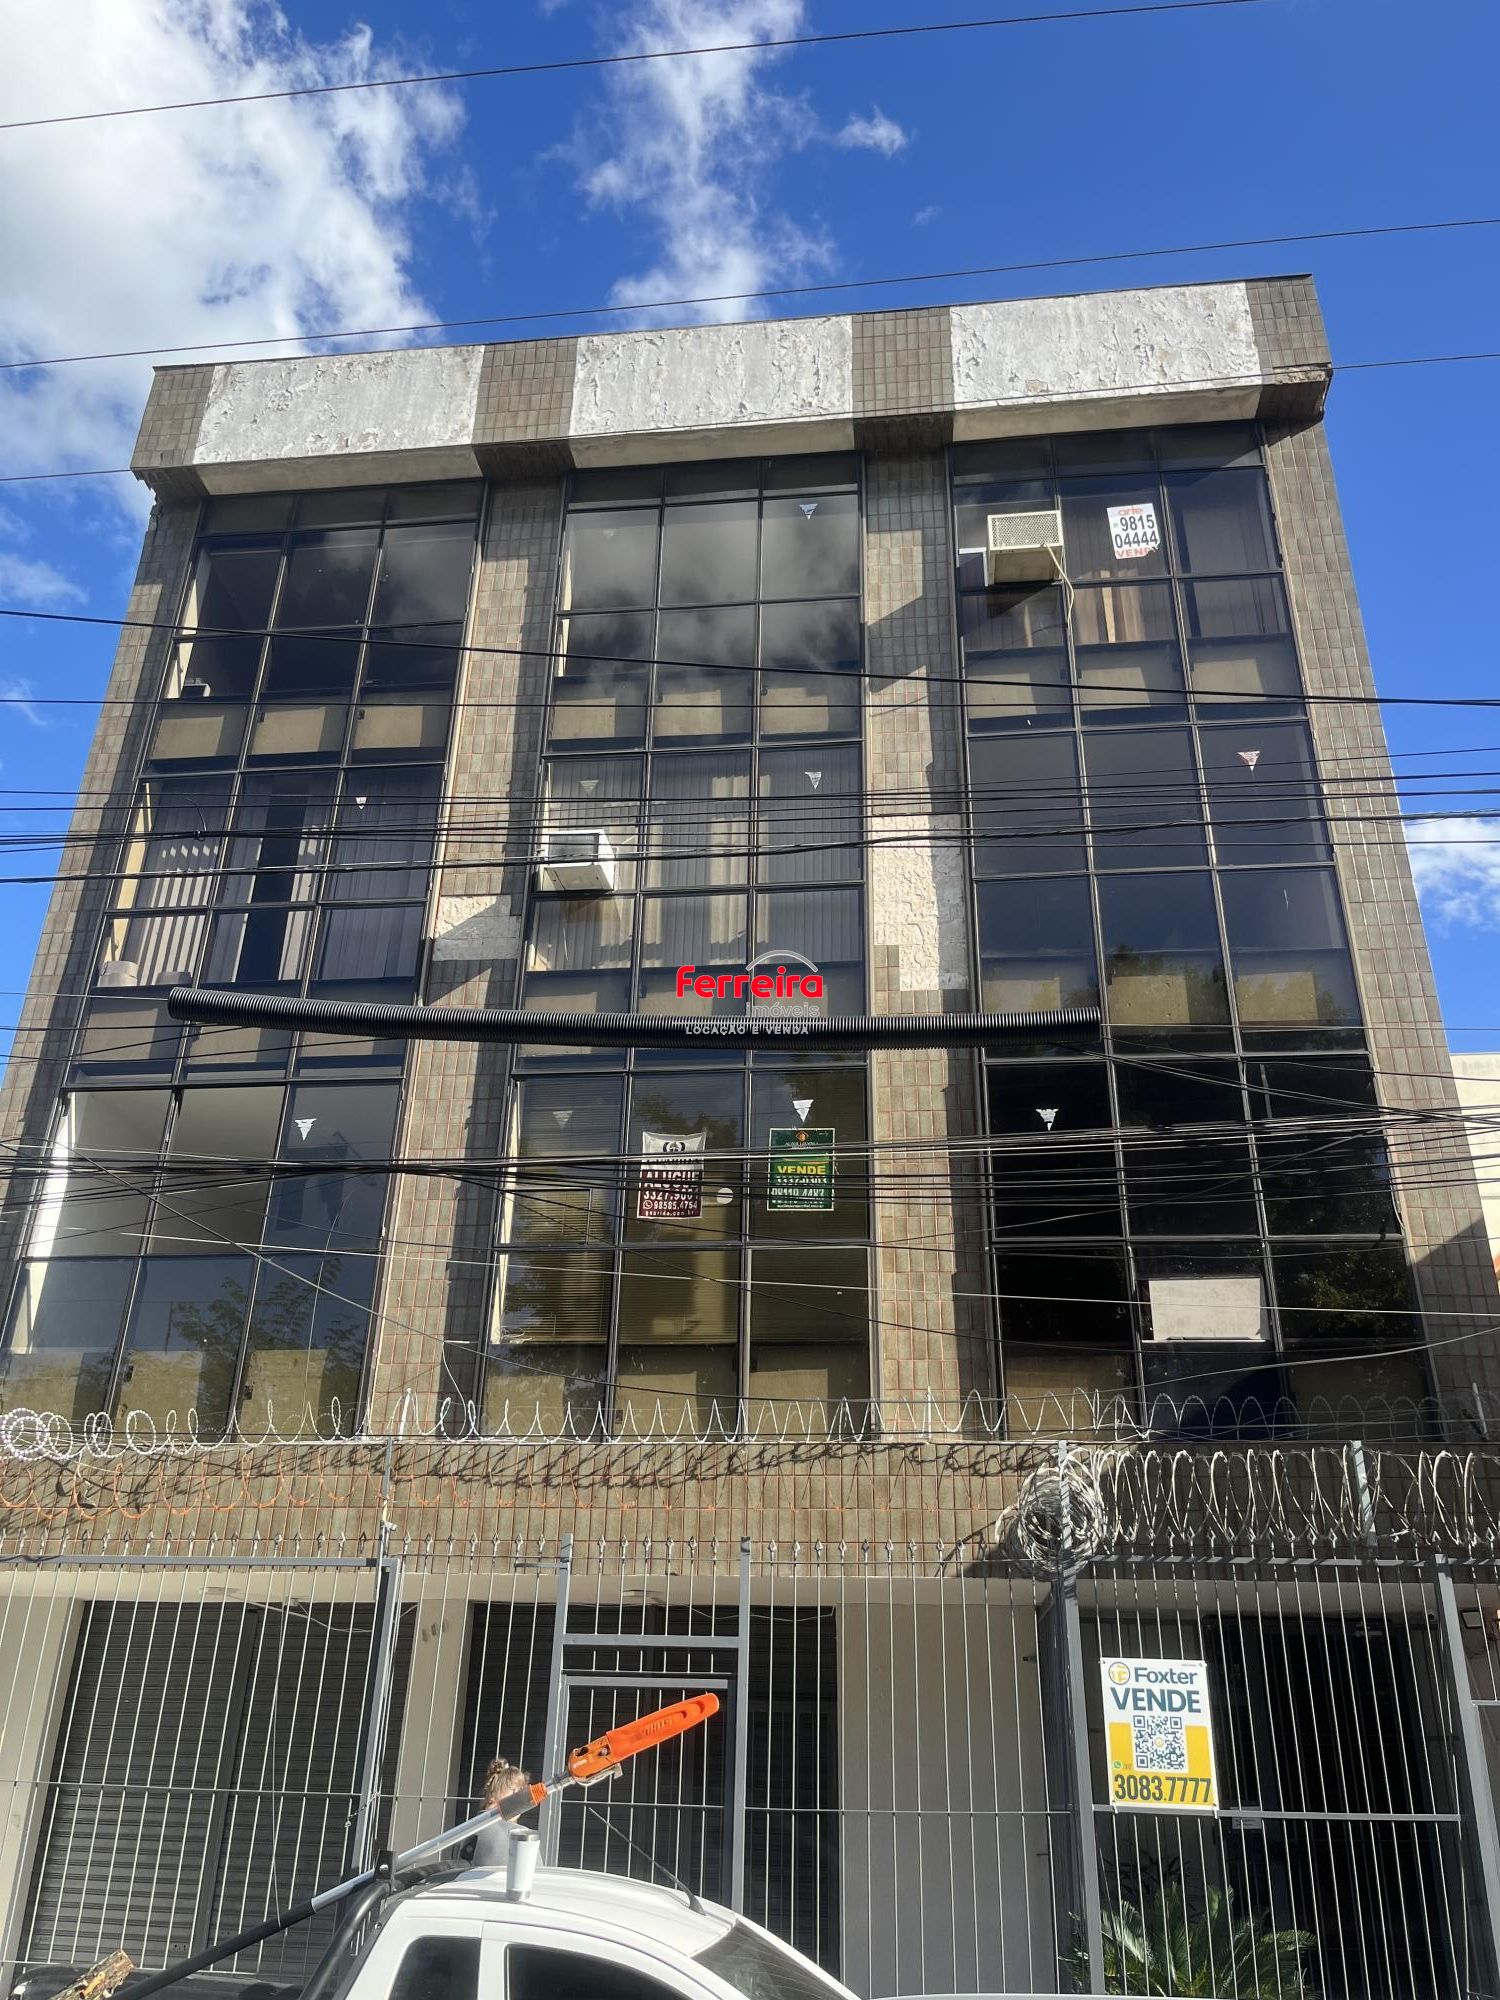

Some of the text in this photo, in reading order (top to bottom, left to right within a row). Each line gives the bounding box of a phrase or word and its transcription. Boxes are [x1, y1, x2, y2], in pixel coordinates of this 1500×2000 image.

[1120, 514, 1155, 532] 9815
[1114, 530, 1159, 549] 04444
[777, 1165, 827, 1175] VENDE
[1134, 1667, 1198, 1685] Foxter
[1110, 1687, 1201, 1713] VENDE
[1114, 1774, 1212, 1803] 3083.7777
